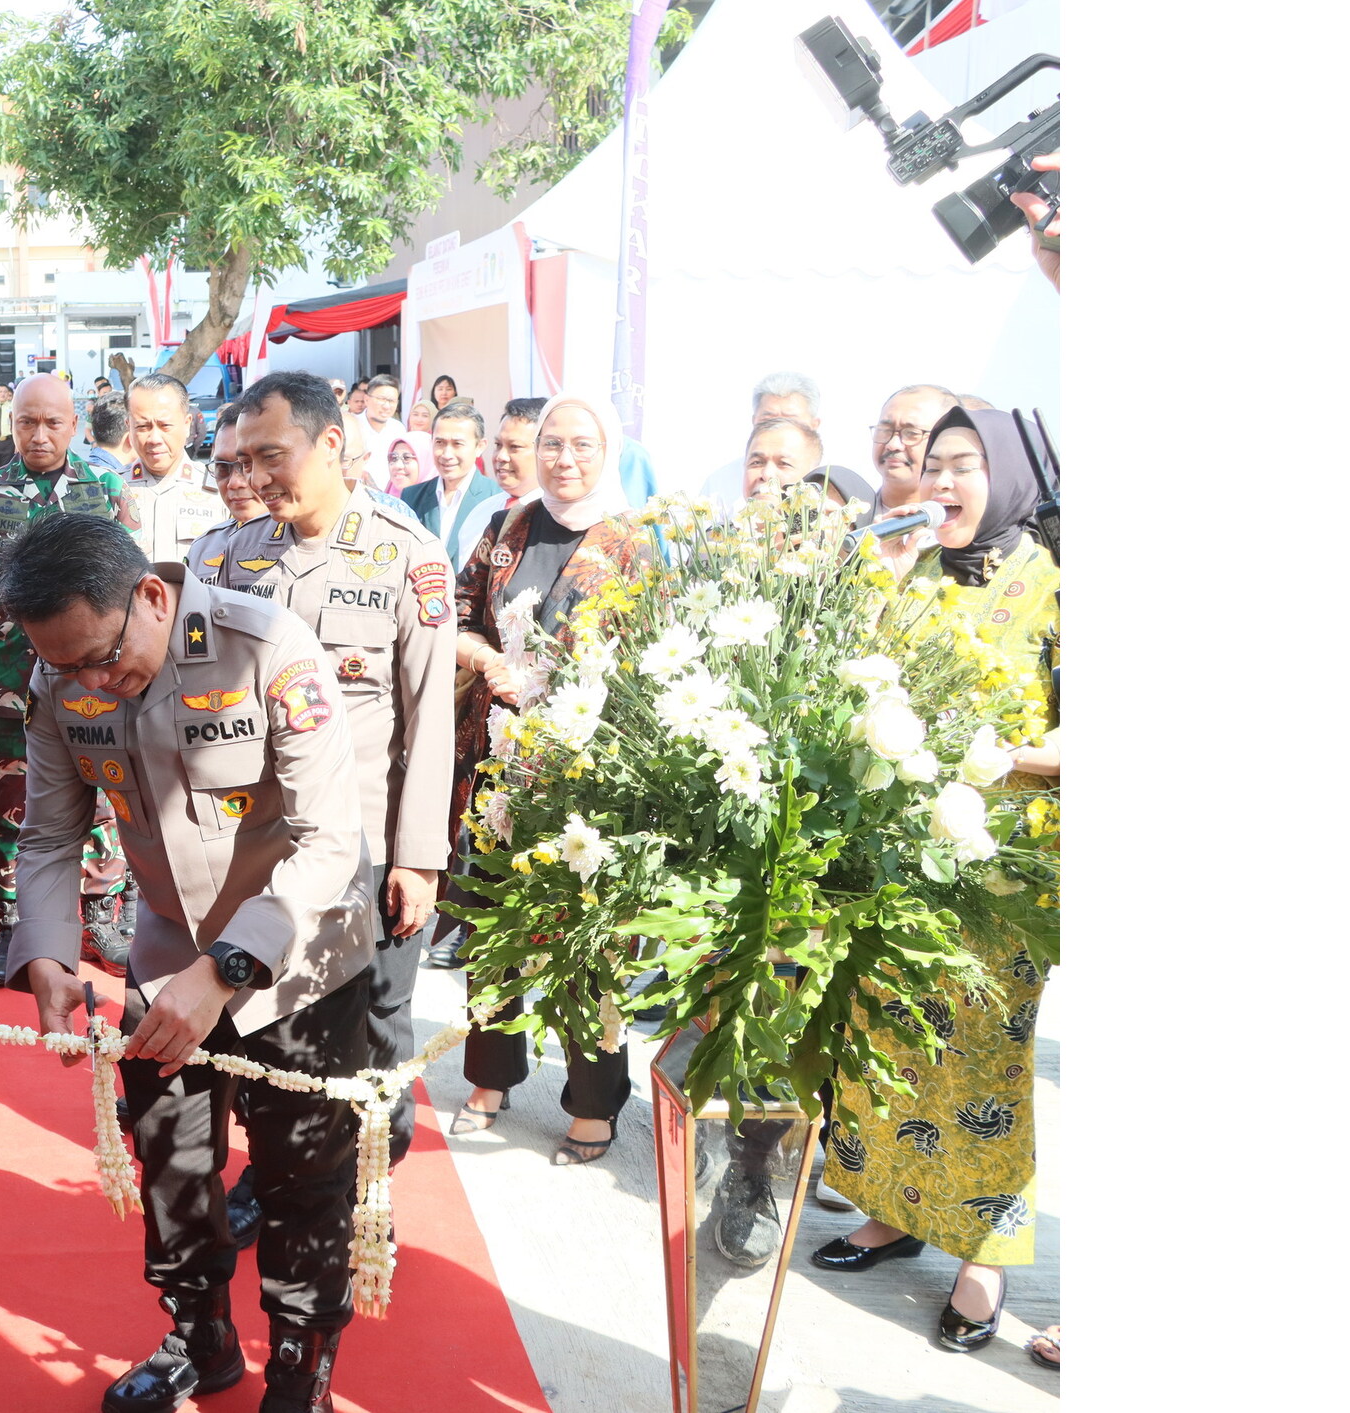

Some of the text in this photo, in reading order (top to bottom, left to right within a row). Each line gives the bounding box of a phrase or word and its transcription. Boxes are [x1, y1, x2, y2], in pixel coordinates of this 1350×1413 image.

[179, 507, 213, 518] POLRI
[414, 563, 444, 577] POLDA
[329, 588, 390, 610] POLRI
[271, 660, 315, 697] PUSDOKKES
[67, 726, 116, 746] PRIMA
[184, 717, 256, 745] POLRI
